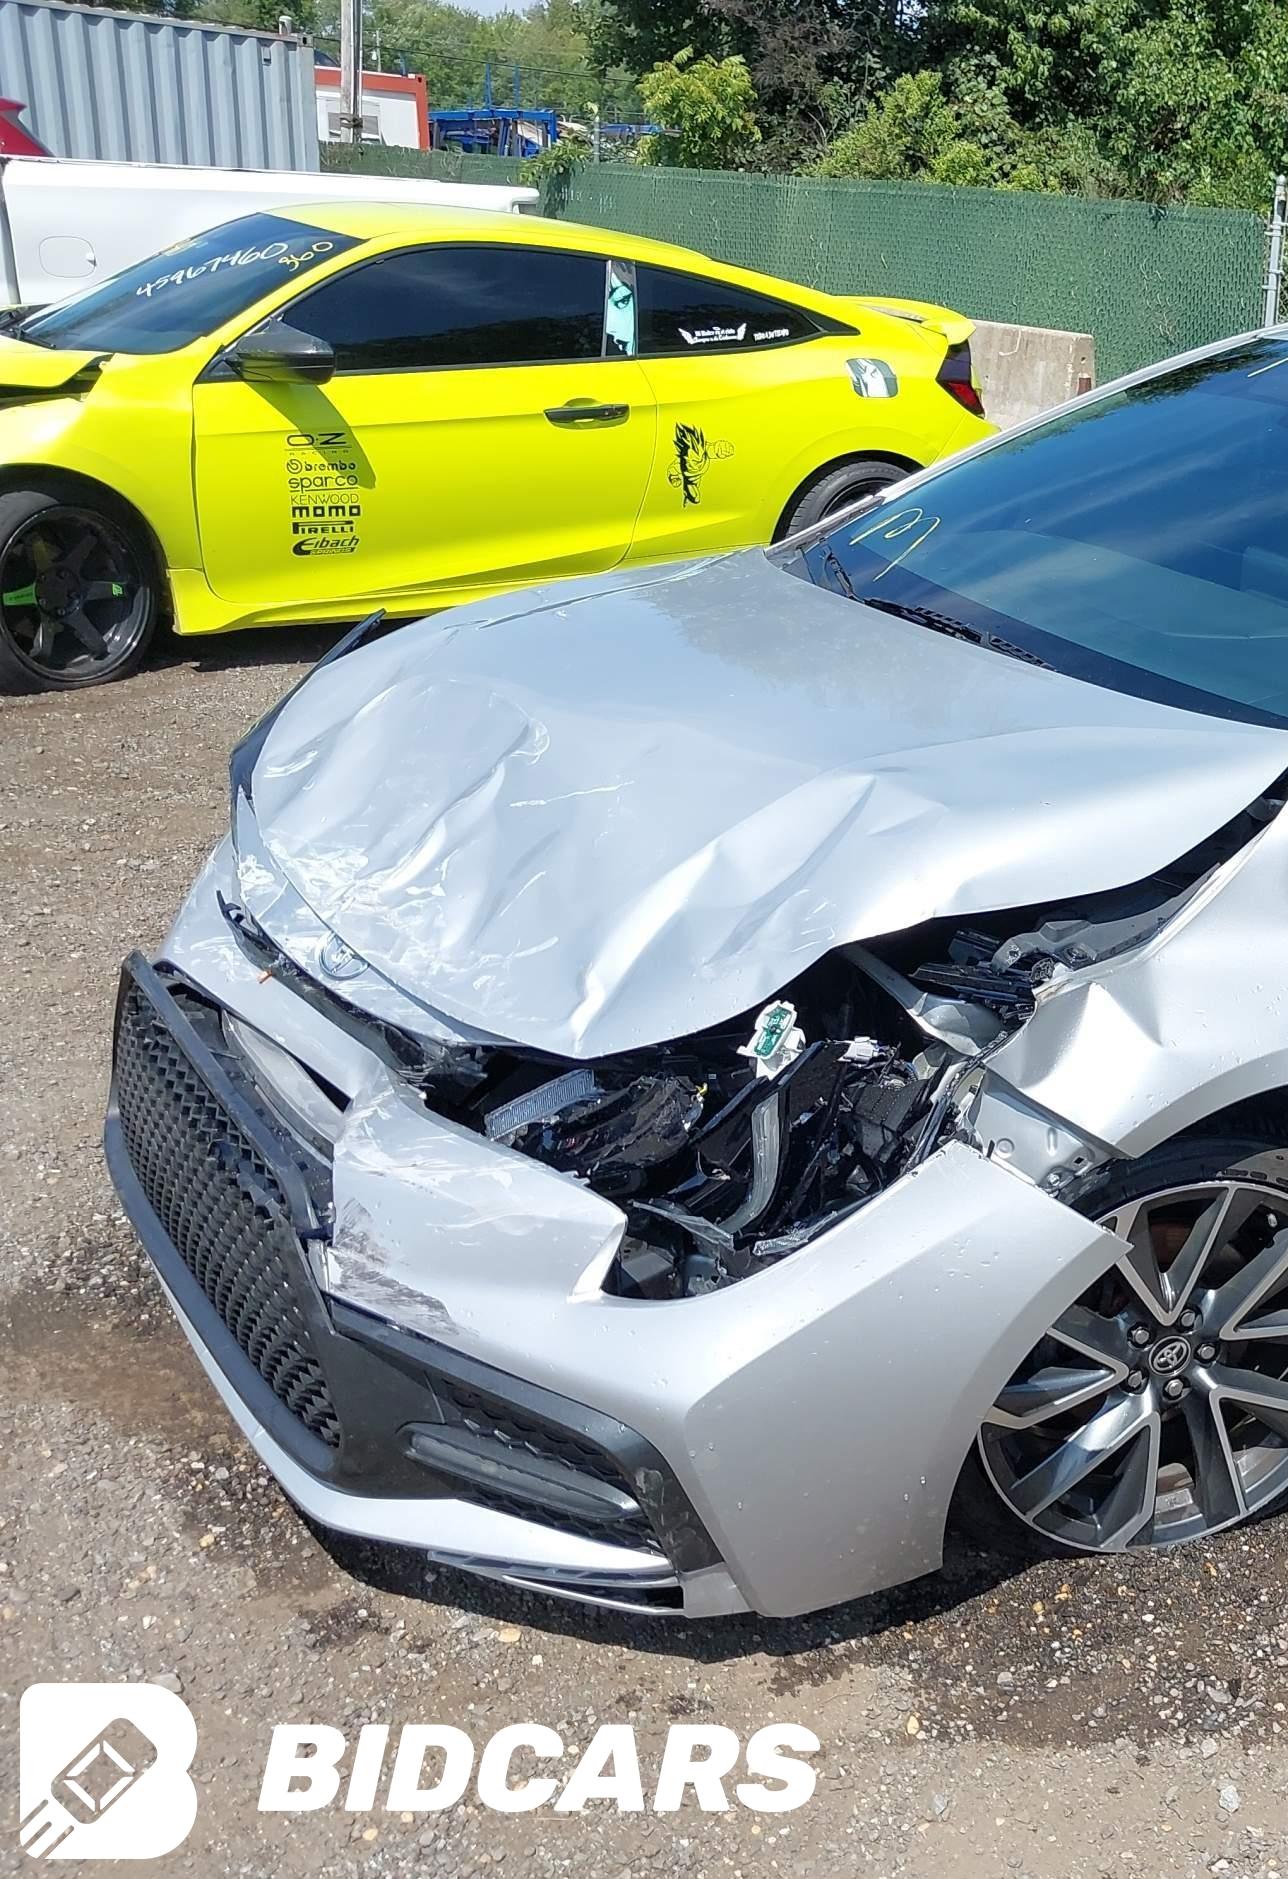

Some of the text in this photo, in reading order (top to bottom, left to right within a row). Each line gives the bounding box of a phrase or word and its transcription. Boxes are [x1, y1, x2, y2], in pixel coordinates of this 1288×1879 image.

[278, 241, 334, 272] 360
[135, 242, 289, 297] 45967460
[304, 459, 356, 472] brembo
[288, 475, 358, 493] sparco
[290, 493, 359, 505] KENWOOD
[292, 535, 360, 556] Eibach
